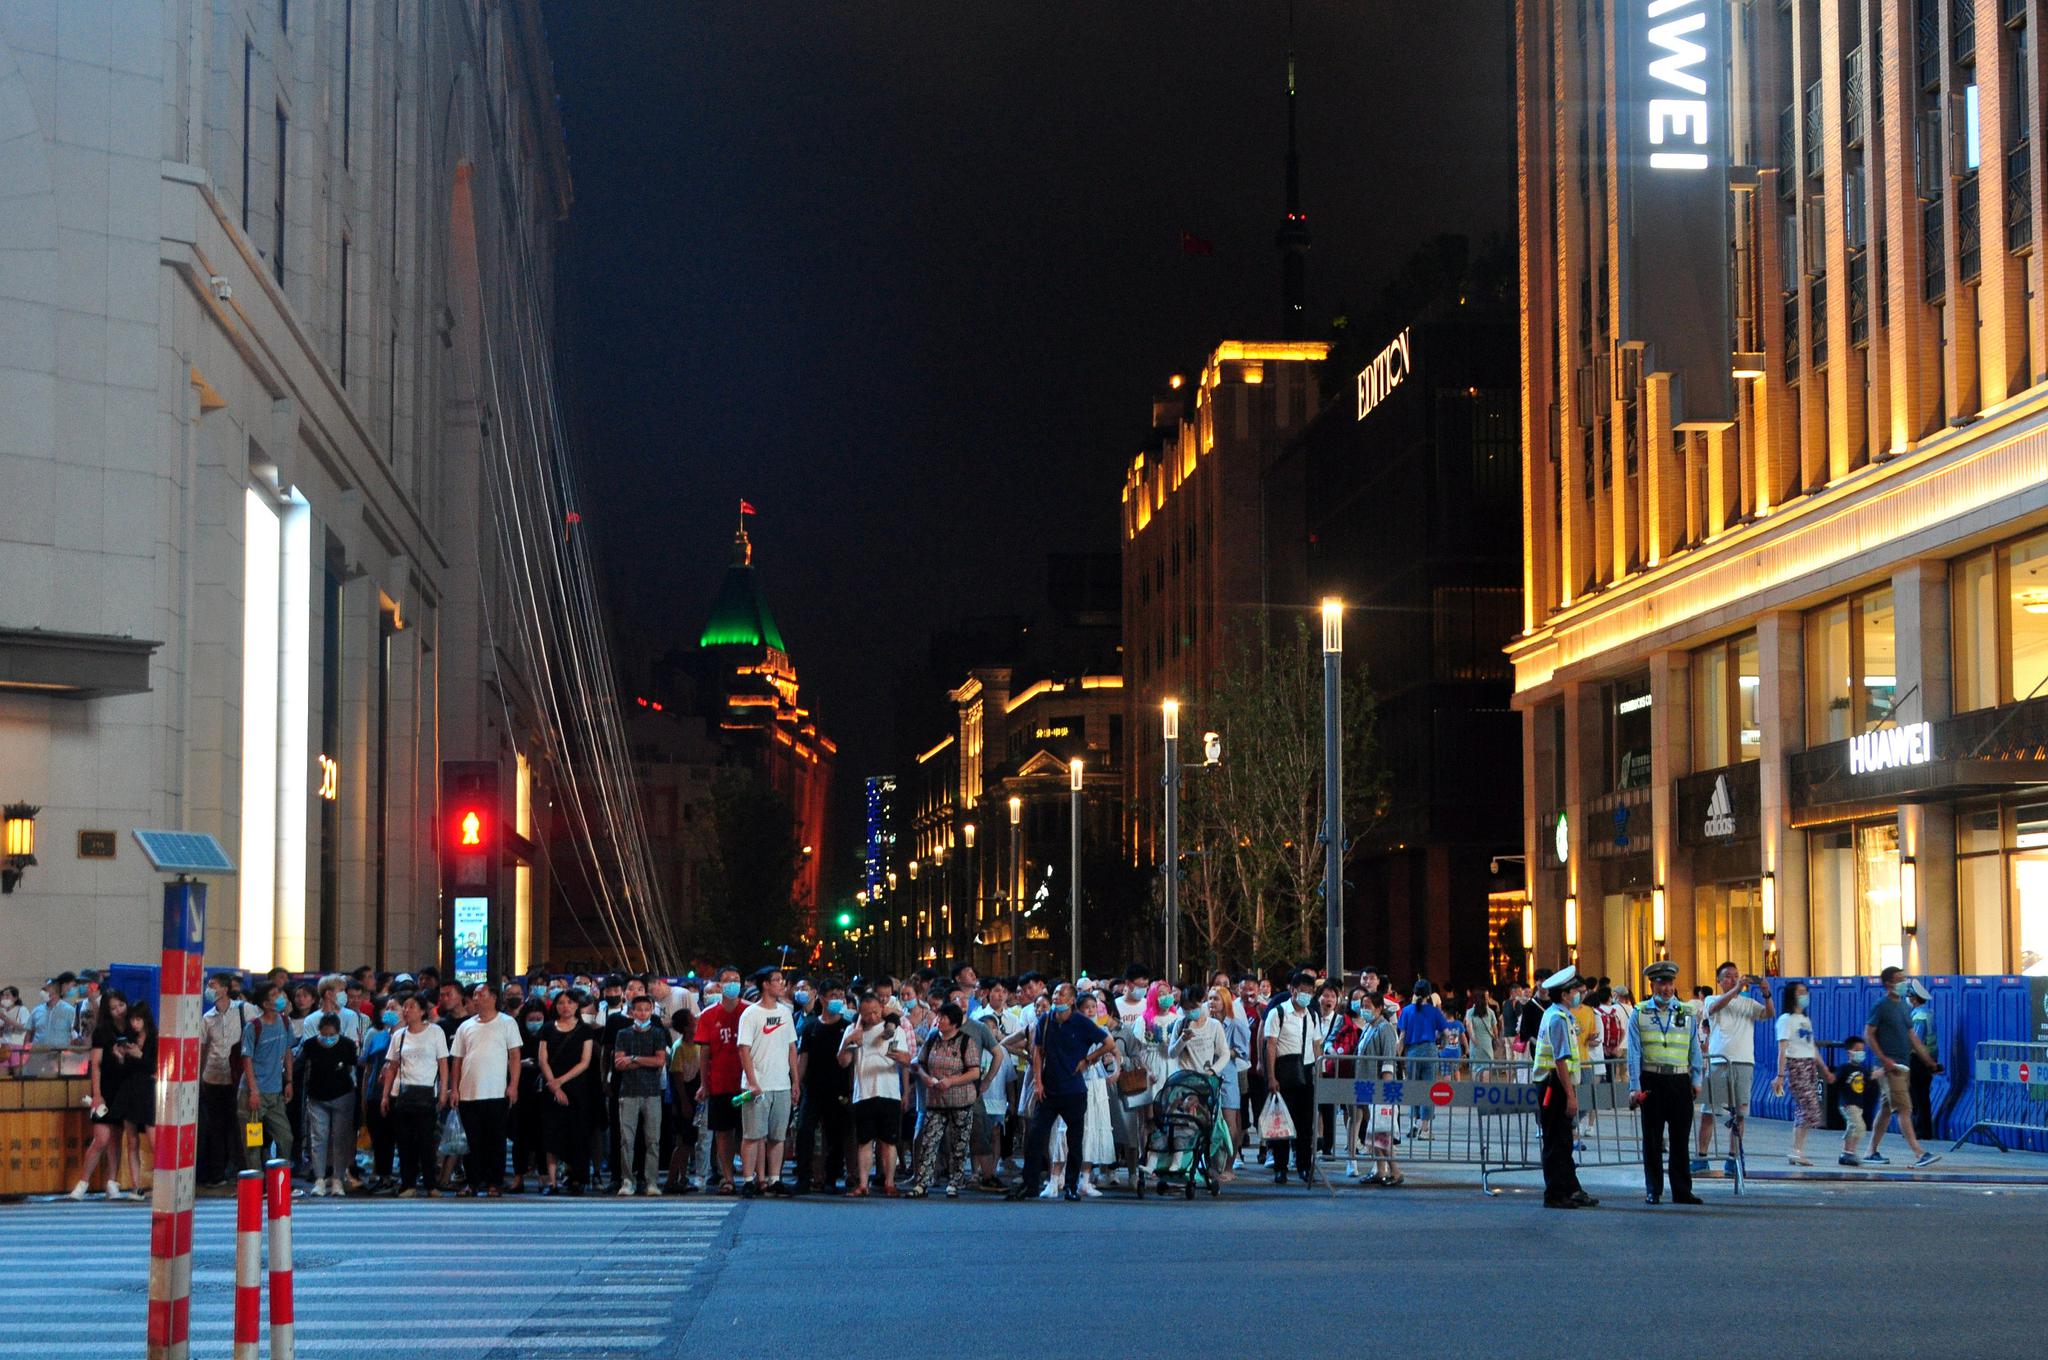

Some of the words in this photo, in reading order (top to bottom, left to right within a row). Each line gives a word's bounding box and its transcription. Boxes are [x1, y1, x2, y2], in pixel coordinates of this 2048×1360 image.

[1648, 0, 1708, 169] WEI
[1358, 326, 1410, 421] EDITION
[1849, 721, 1931, 775] HUAWEI
[1704, 815, 1736, 837] adidas
[766, 1017, 782, 1026] NIKE
[1354, 1081, 1404, 1103] 警察
[1473, 1087, 1537, 1105] POLIC
